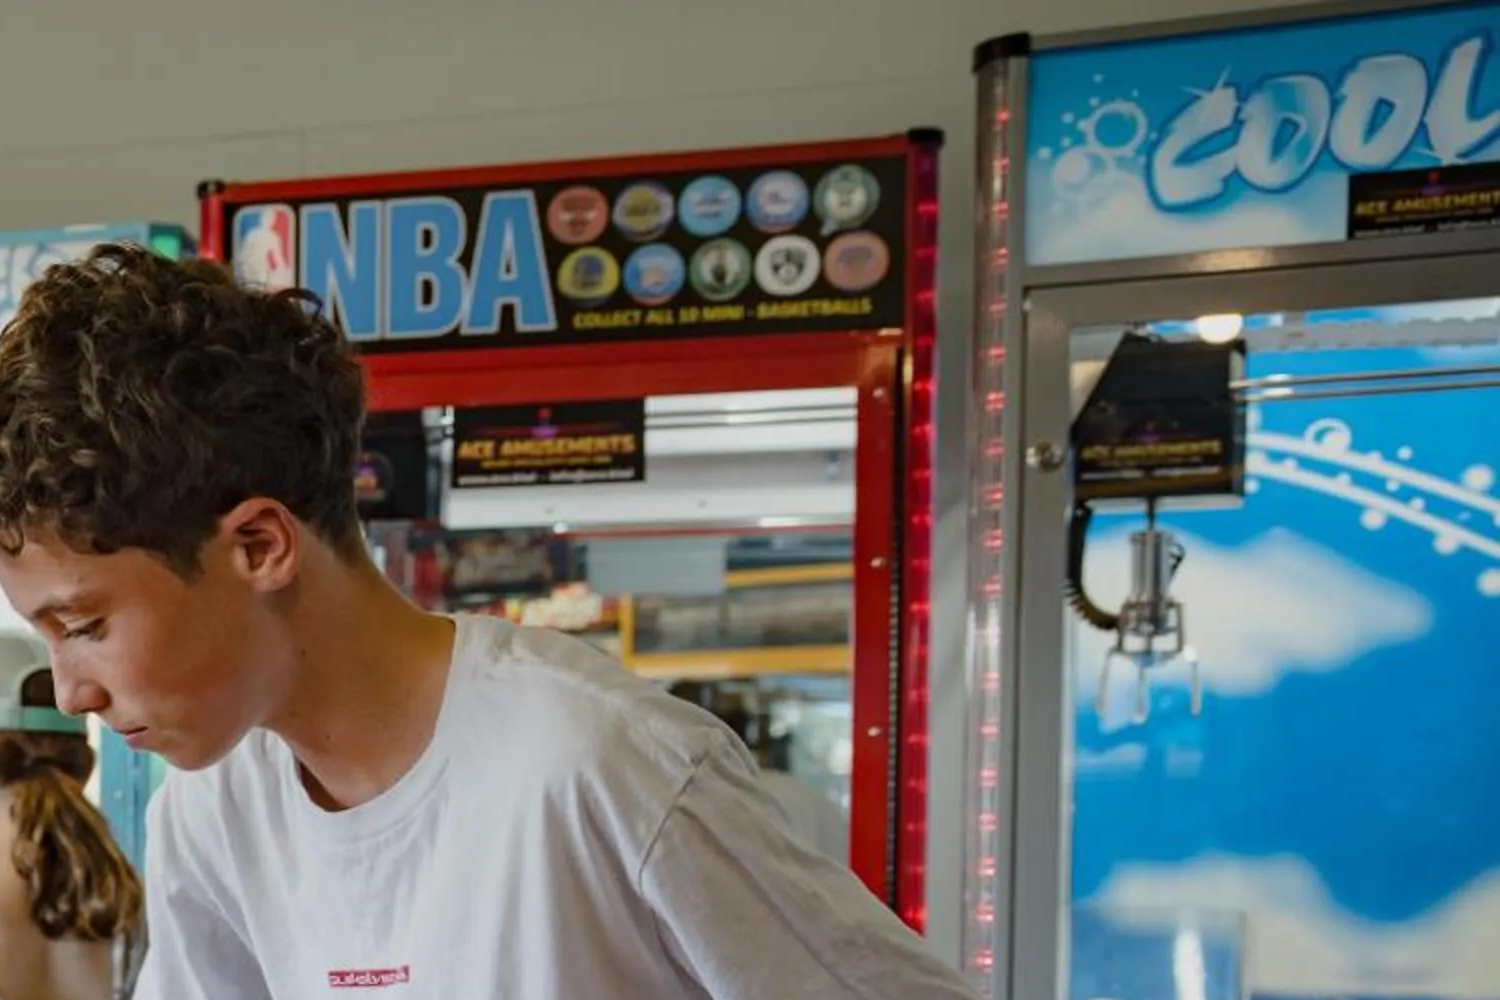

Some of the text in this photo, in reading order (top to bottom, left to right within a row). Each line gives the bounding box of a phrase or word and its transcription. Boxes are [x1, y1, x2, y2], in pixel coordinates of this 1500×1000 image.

[1148, 35, 1500, 211] COOL
[300, 189, 557, 341] NBA
[457, 440, 495, 459] ACE
